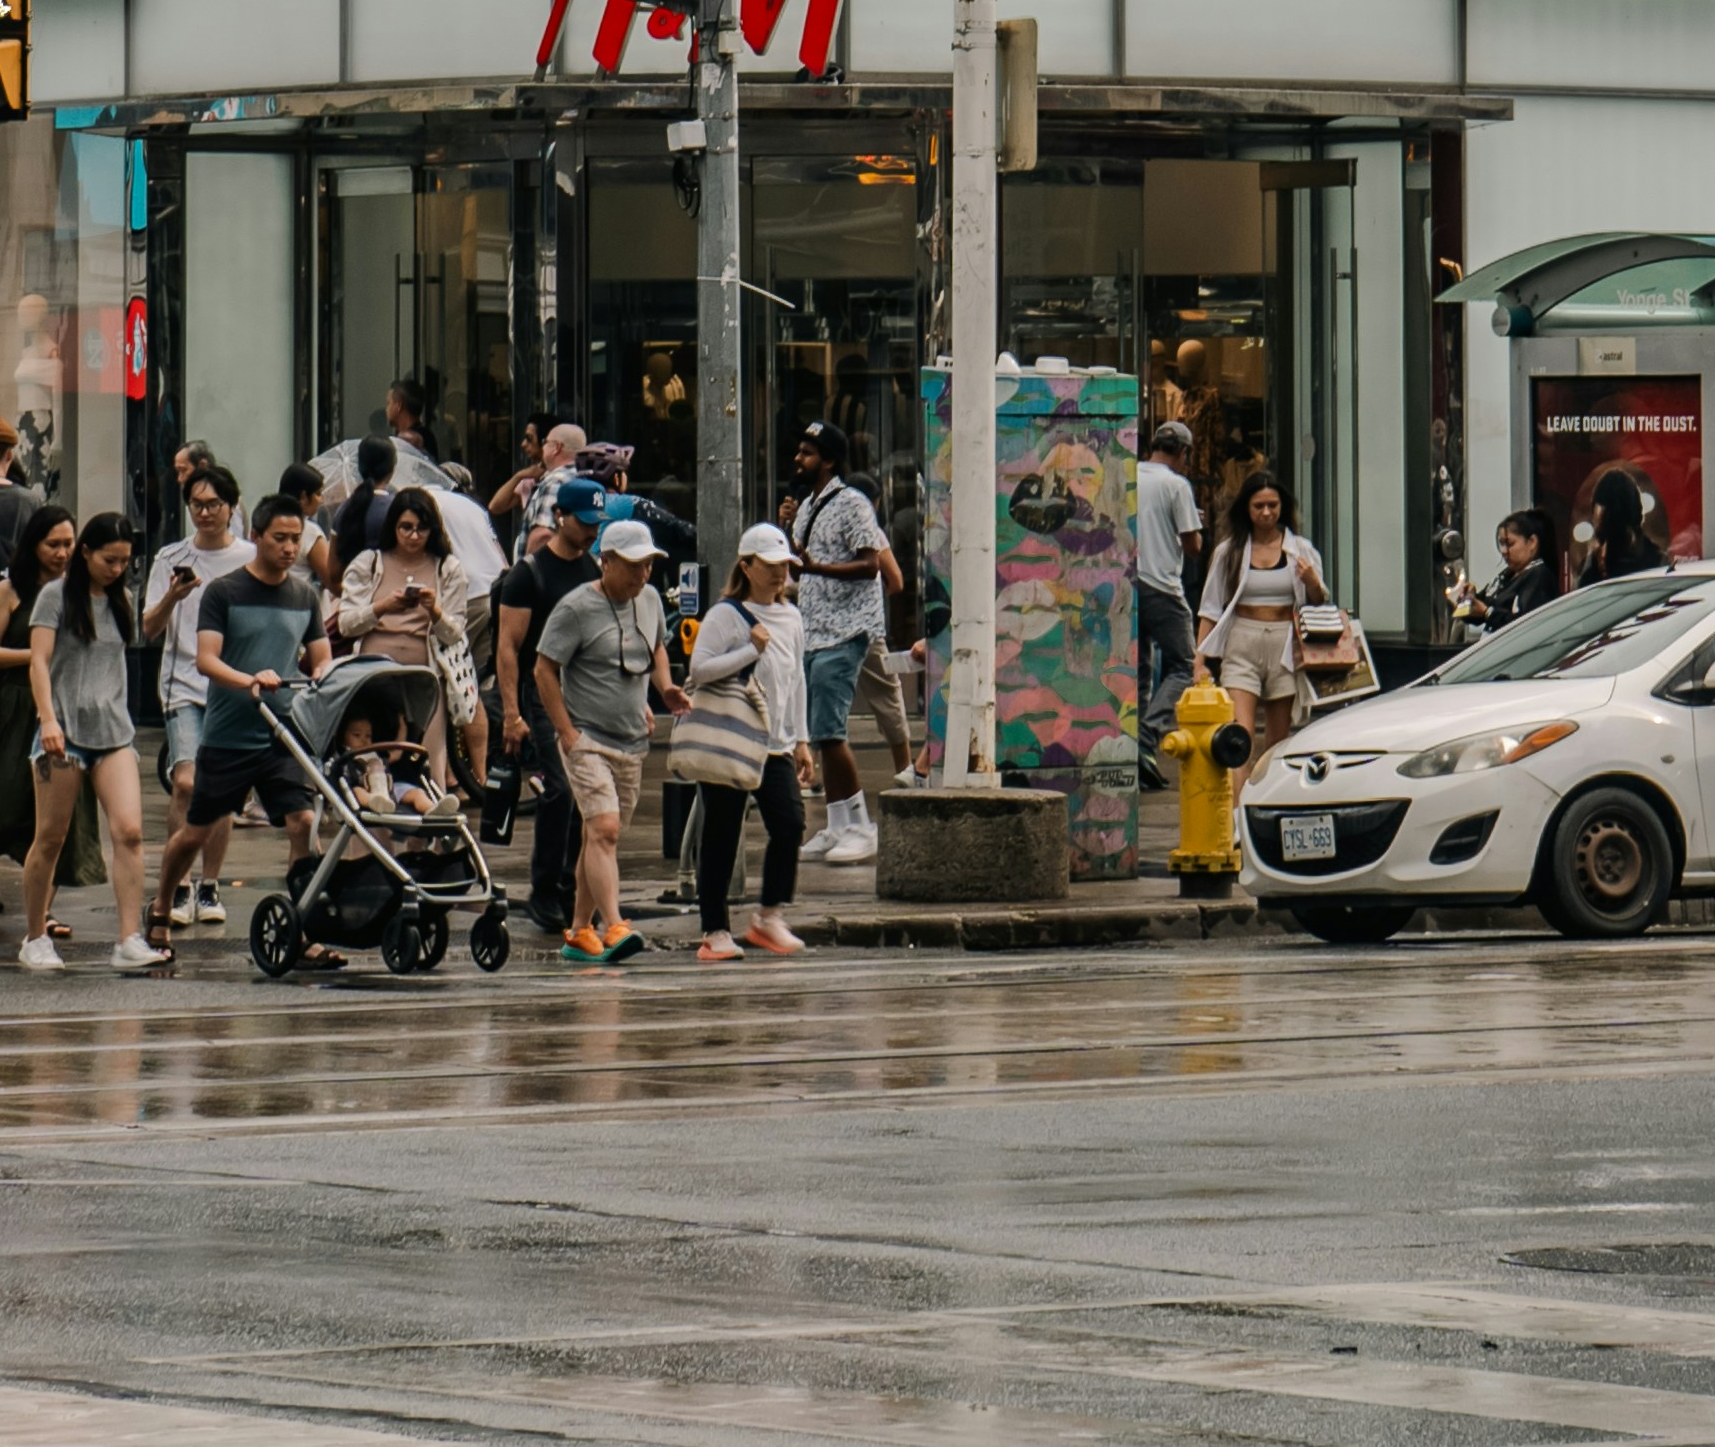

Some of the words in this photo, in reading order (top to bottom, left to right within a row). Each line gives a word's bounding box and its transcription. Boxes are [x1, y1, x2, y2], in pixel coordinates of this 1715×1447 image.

[1617, 289, 1667, 314] Yonge
[1603, 352, 1623, 361] astral
[1547, 415, 1580, 432] LEAVE
[1583, 415, 1620, 432] DOUBT
[1623, 415, 1635, 432] IN
[1638, 415, 1660, 432] THE
[1663, 415, 1697, 432] DUST.
